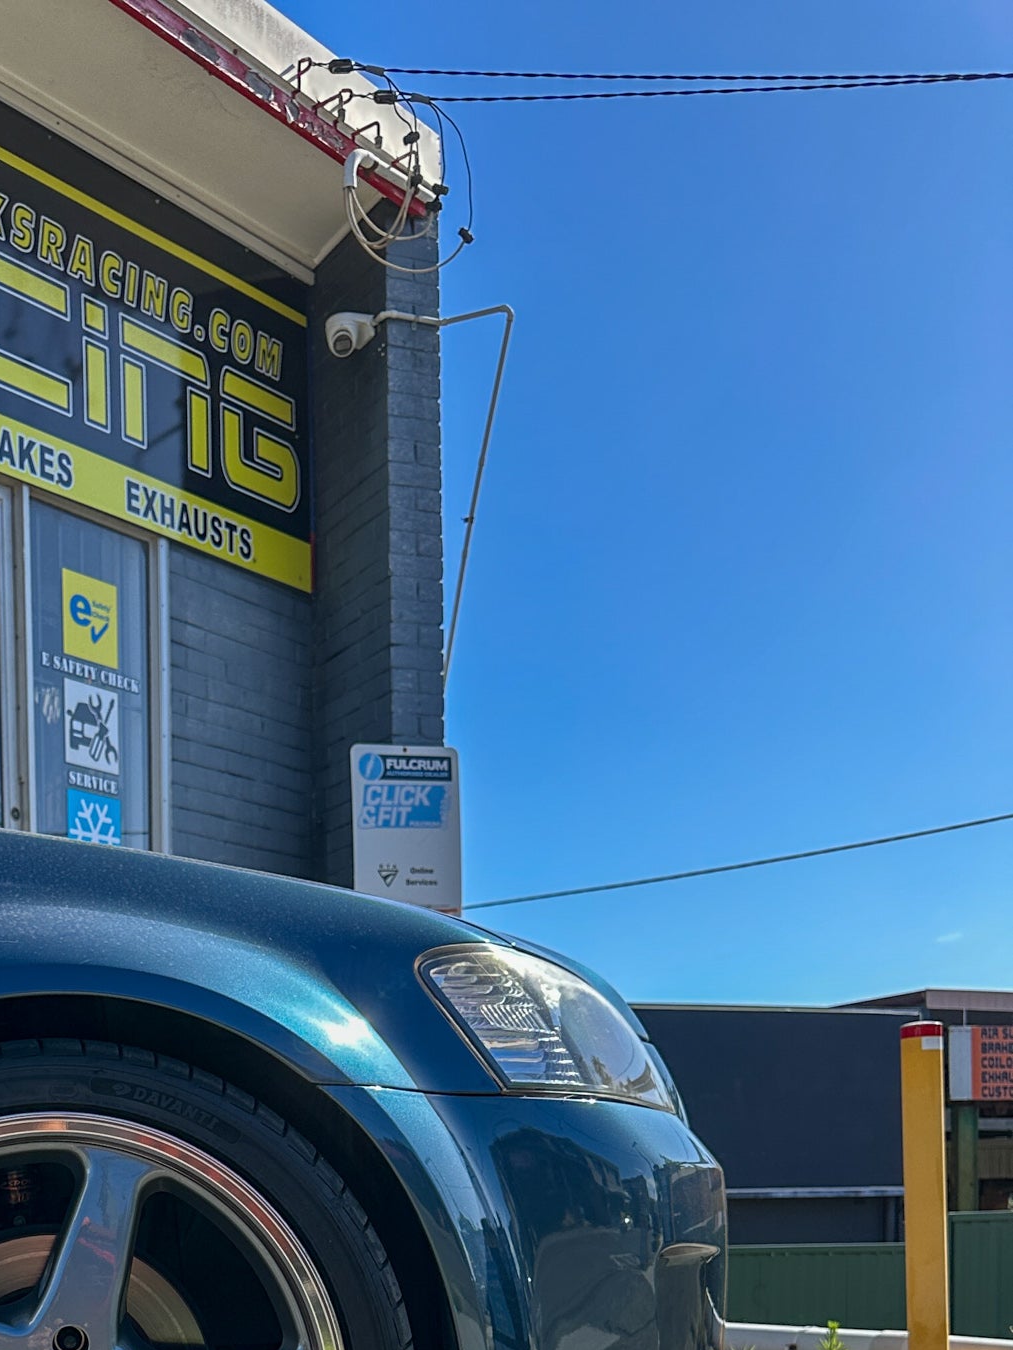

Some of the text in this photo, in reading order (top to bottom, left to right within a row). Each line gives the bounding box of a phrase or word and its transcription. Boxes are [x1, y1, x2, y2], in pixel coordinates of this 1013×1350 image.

[125, 478, 254, 562] EXHAUSTS
[42, 651, 140, 693] E SAFETY CHECK
[385, 758, 448, 771] FULCRUM
[68, 770, 118, 794] SERVICE
[366, 786, 432, 807] CLICK
[981, 1027, 998, 1039] AIR
